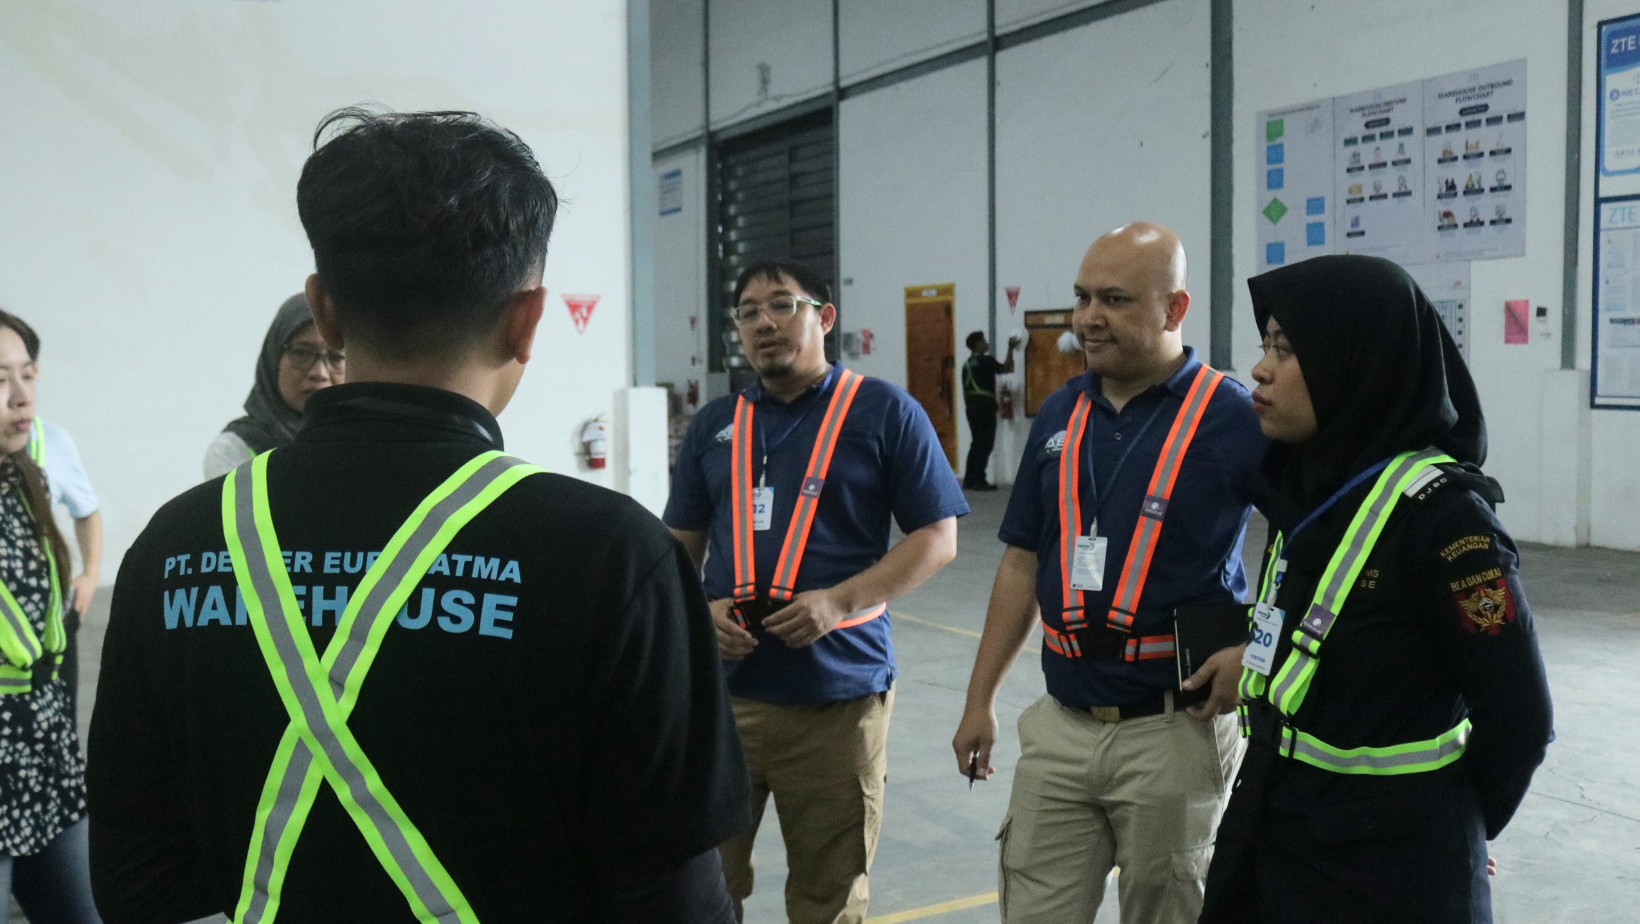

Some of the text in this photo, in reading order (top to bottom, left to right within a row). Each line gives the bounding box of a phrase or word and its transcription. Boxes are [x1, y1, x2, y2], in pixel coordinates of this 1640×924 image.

[1611, 34, 1637, 54] ZTE
[1608, 206, 1637, 224] ZTE
[1440, 535, 1491, 558] KEMENTERIAN
[1446, 542, 1489, 562] KEUANGAN
[164, 551, 522, 584] PT. DEER EUATMA
[1450, 567, 1503, 592] BEA DAN CUKAI
[163, 586, 519, 640] WAHUSE
[1254, 628, 1273, 648] 20
